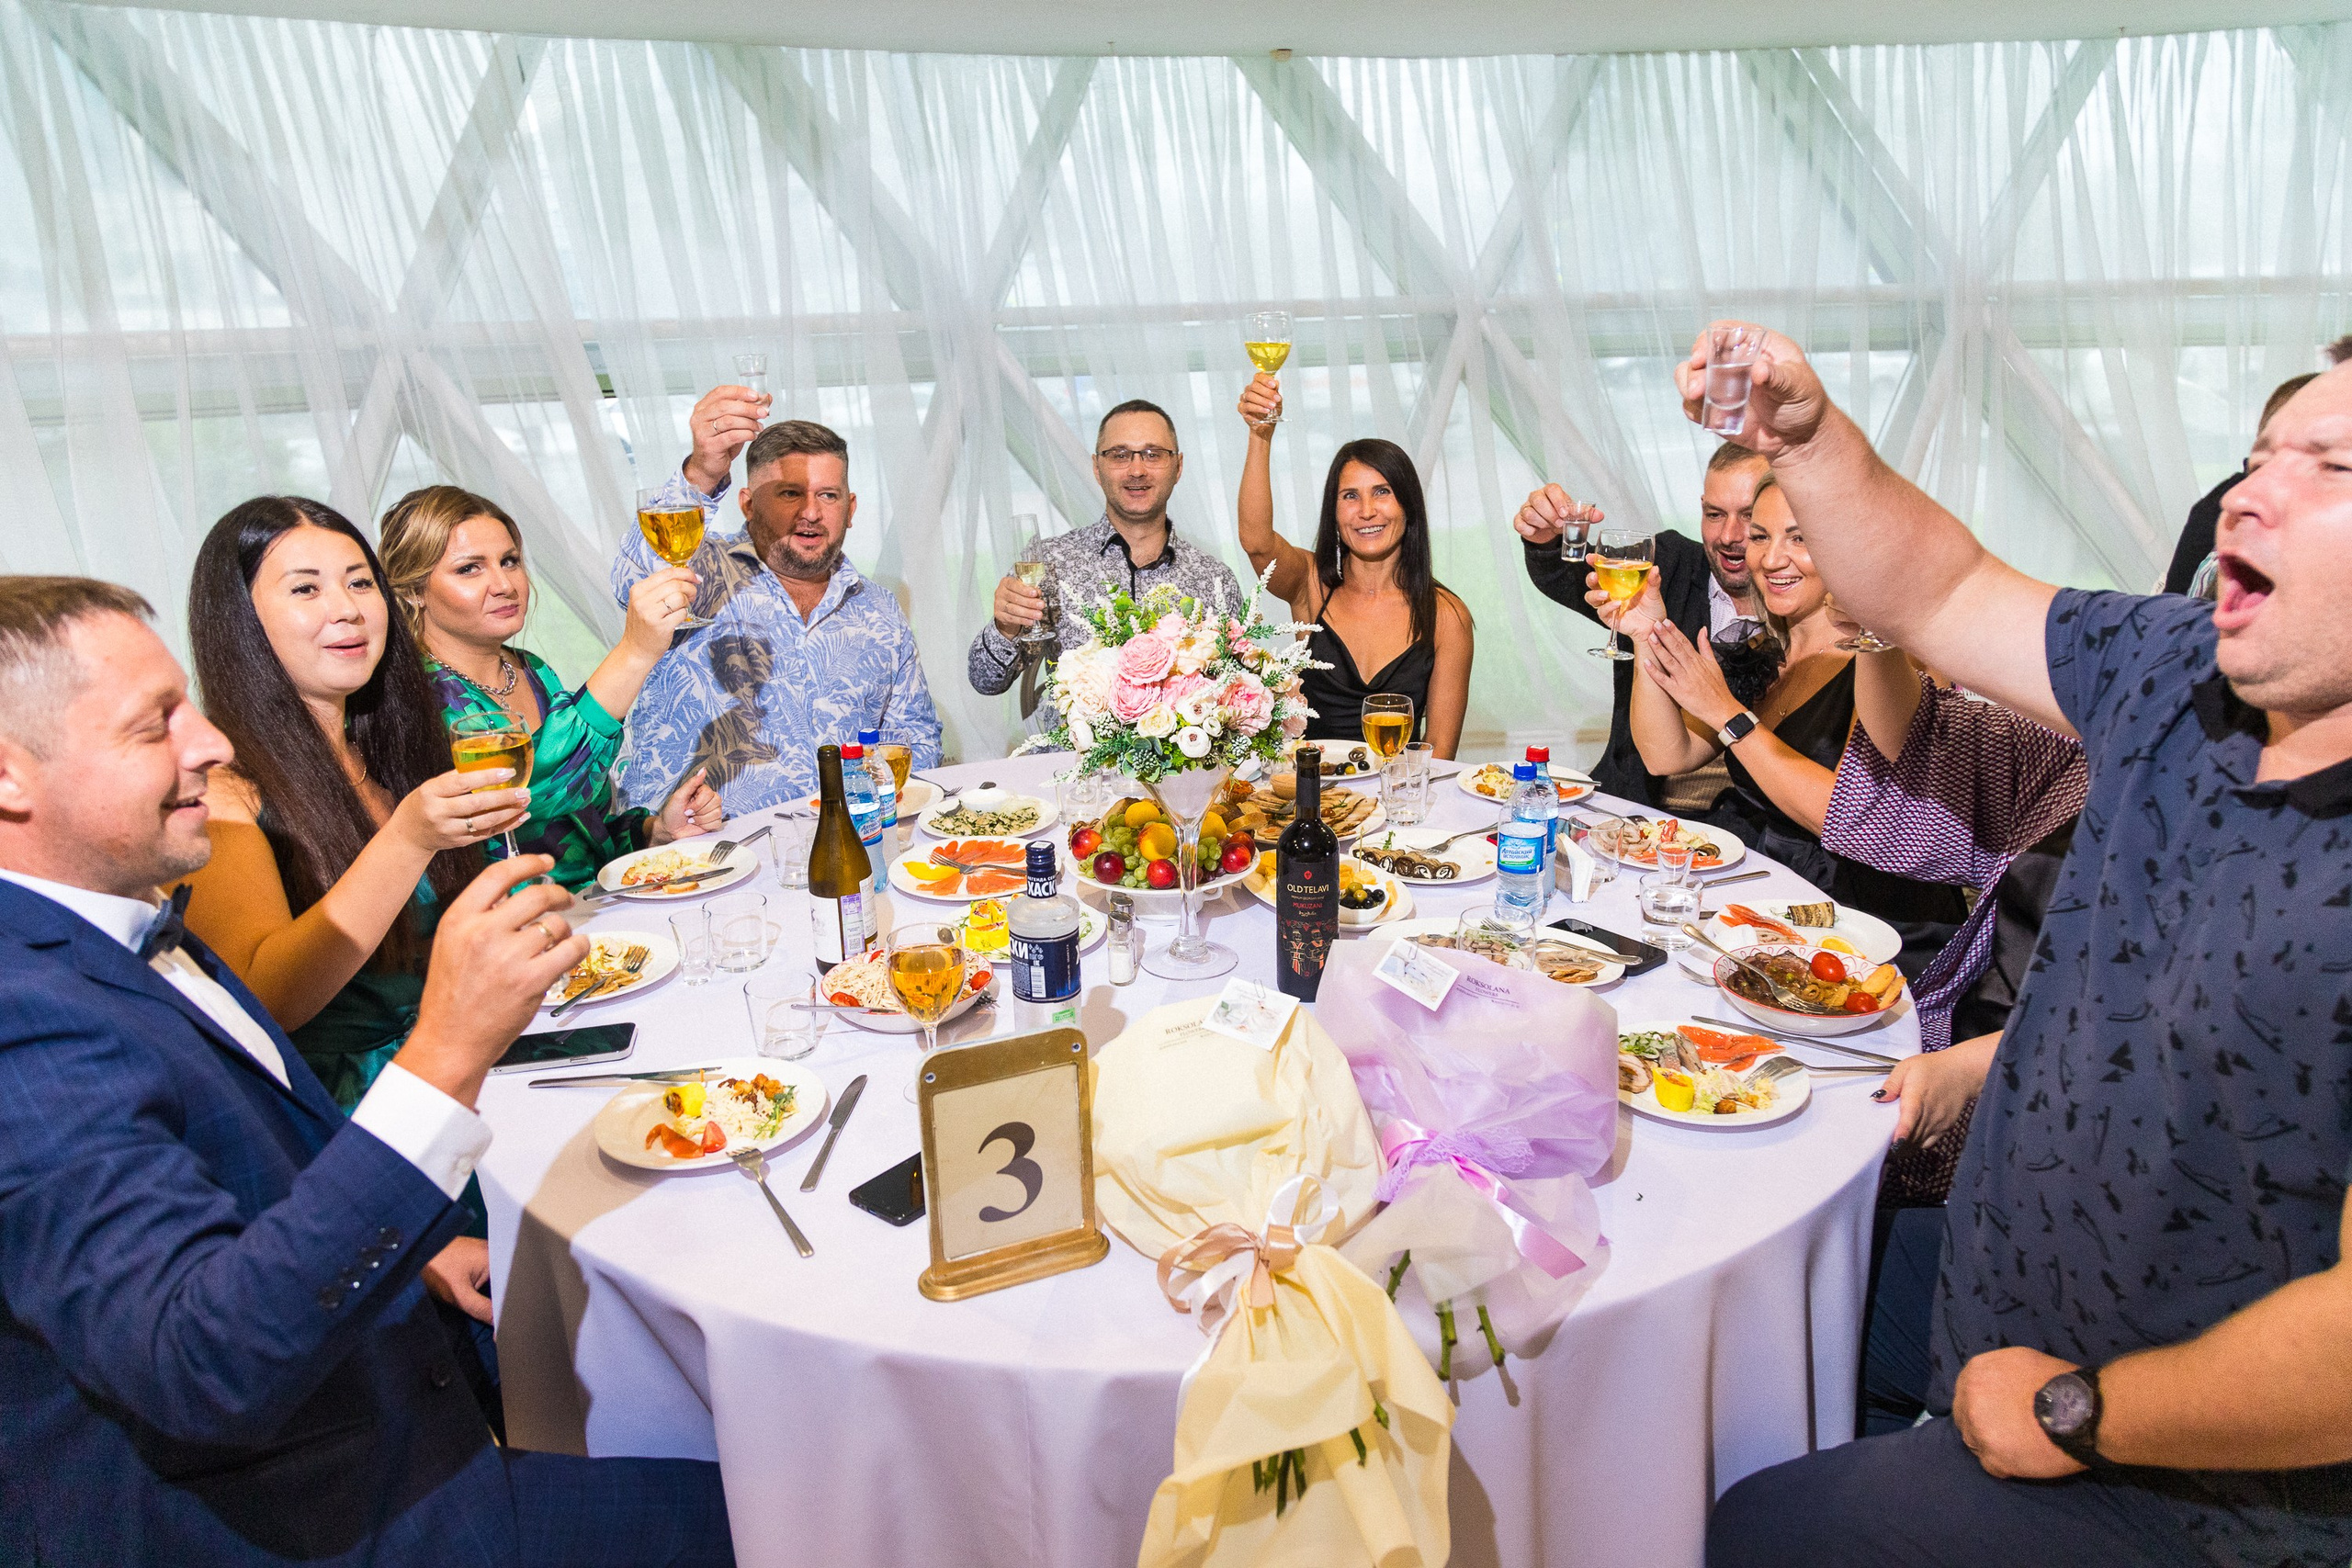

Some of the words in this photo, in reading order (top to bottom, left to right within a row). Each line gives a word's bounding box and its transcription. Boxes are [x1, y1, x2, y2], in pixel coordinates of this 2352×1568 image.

[1287, 884, 1304, 893] OLD
[1304, 885, 1329, 893] TELAVI
[1466, 975, 1510, 994] ROKSOLANA
[1476, 987, 1498, 997] FLOWERS
[978, 1121, 1044, 1224] 3
